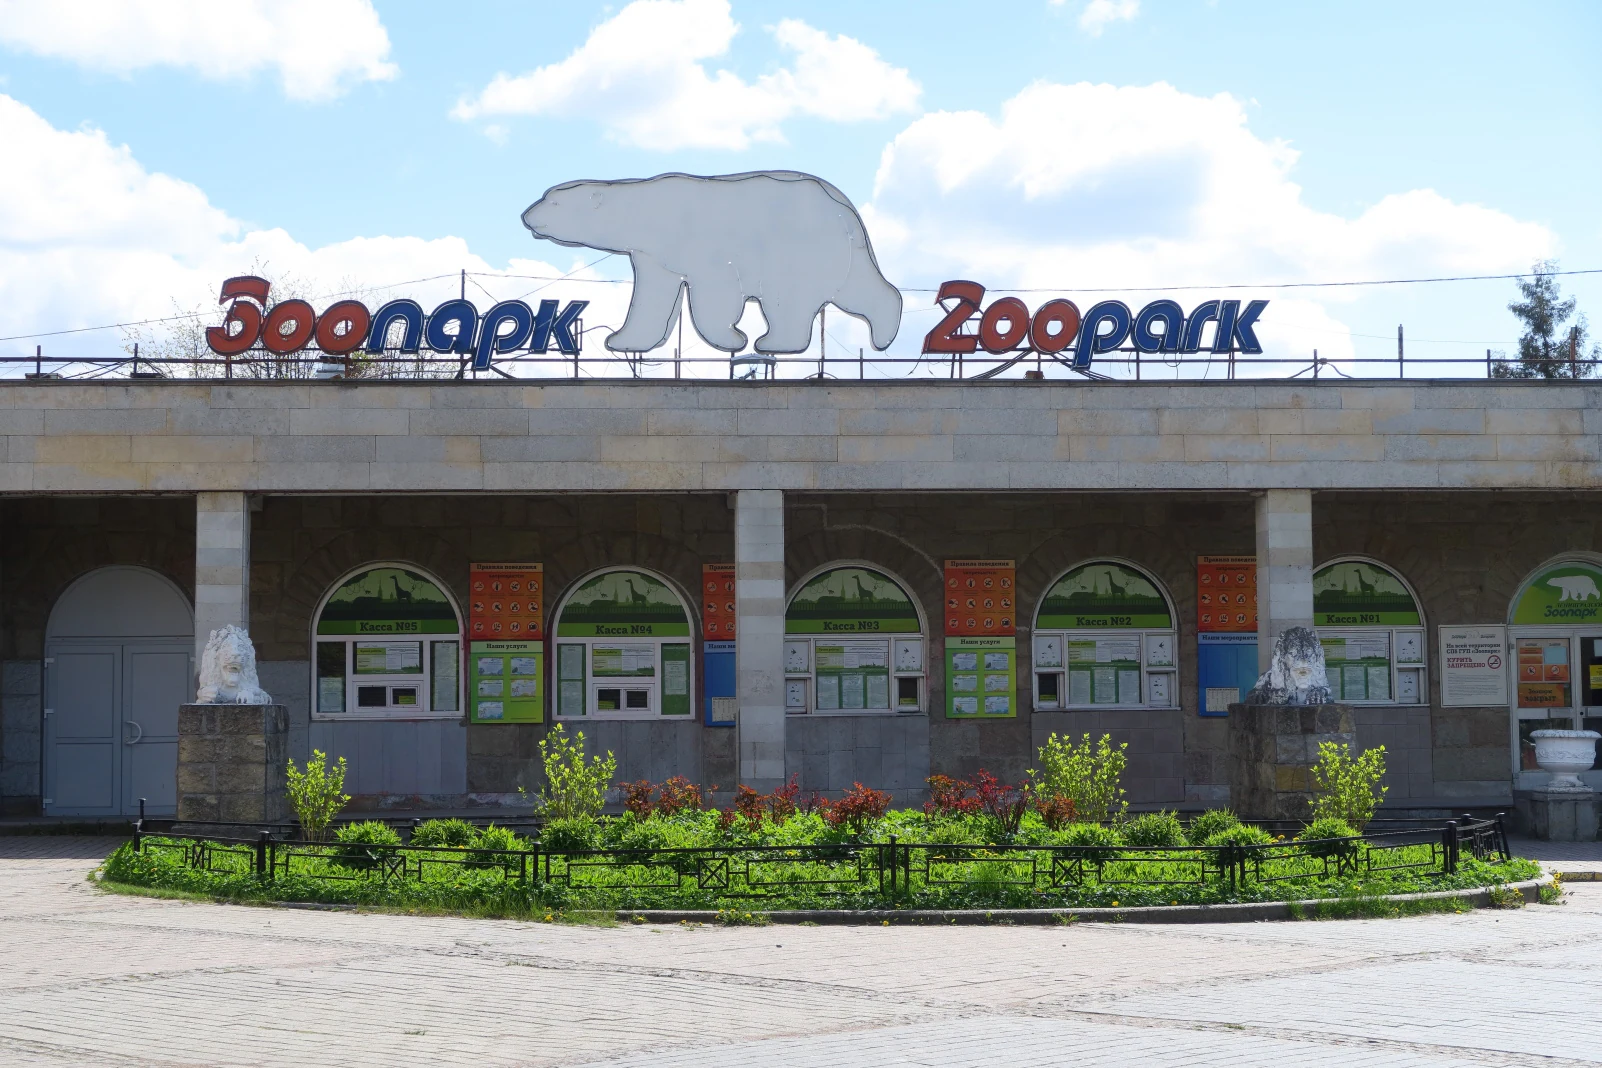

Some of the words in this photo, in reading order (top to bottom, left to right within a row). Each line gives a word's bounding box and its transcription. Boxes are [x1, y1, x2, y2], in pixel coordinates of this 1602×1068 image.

[206, 275, 590, 371] Зоопарк
[922, 280, 1270, 371] Zoopark
[1544, 605, 1598, 619] Зоопарк
[1076, 616, 1108, 626] Касса
[1110, 616, 1132, 626] №2
[1326, 614, 1358, 624] Касса
[1360, 614, 1380, 623] №1
[360, 622, 392, 631] Касса
[396, 622, 418, 630] №5
[596, 626, 628, 634] Касса
[631, 626, 652, 634] №4
[824, 622, 855, 630] Касса
[858, 621, 880, 630] №3
